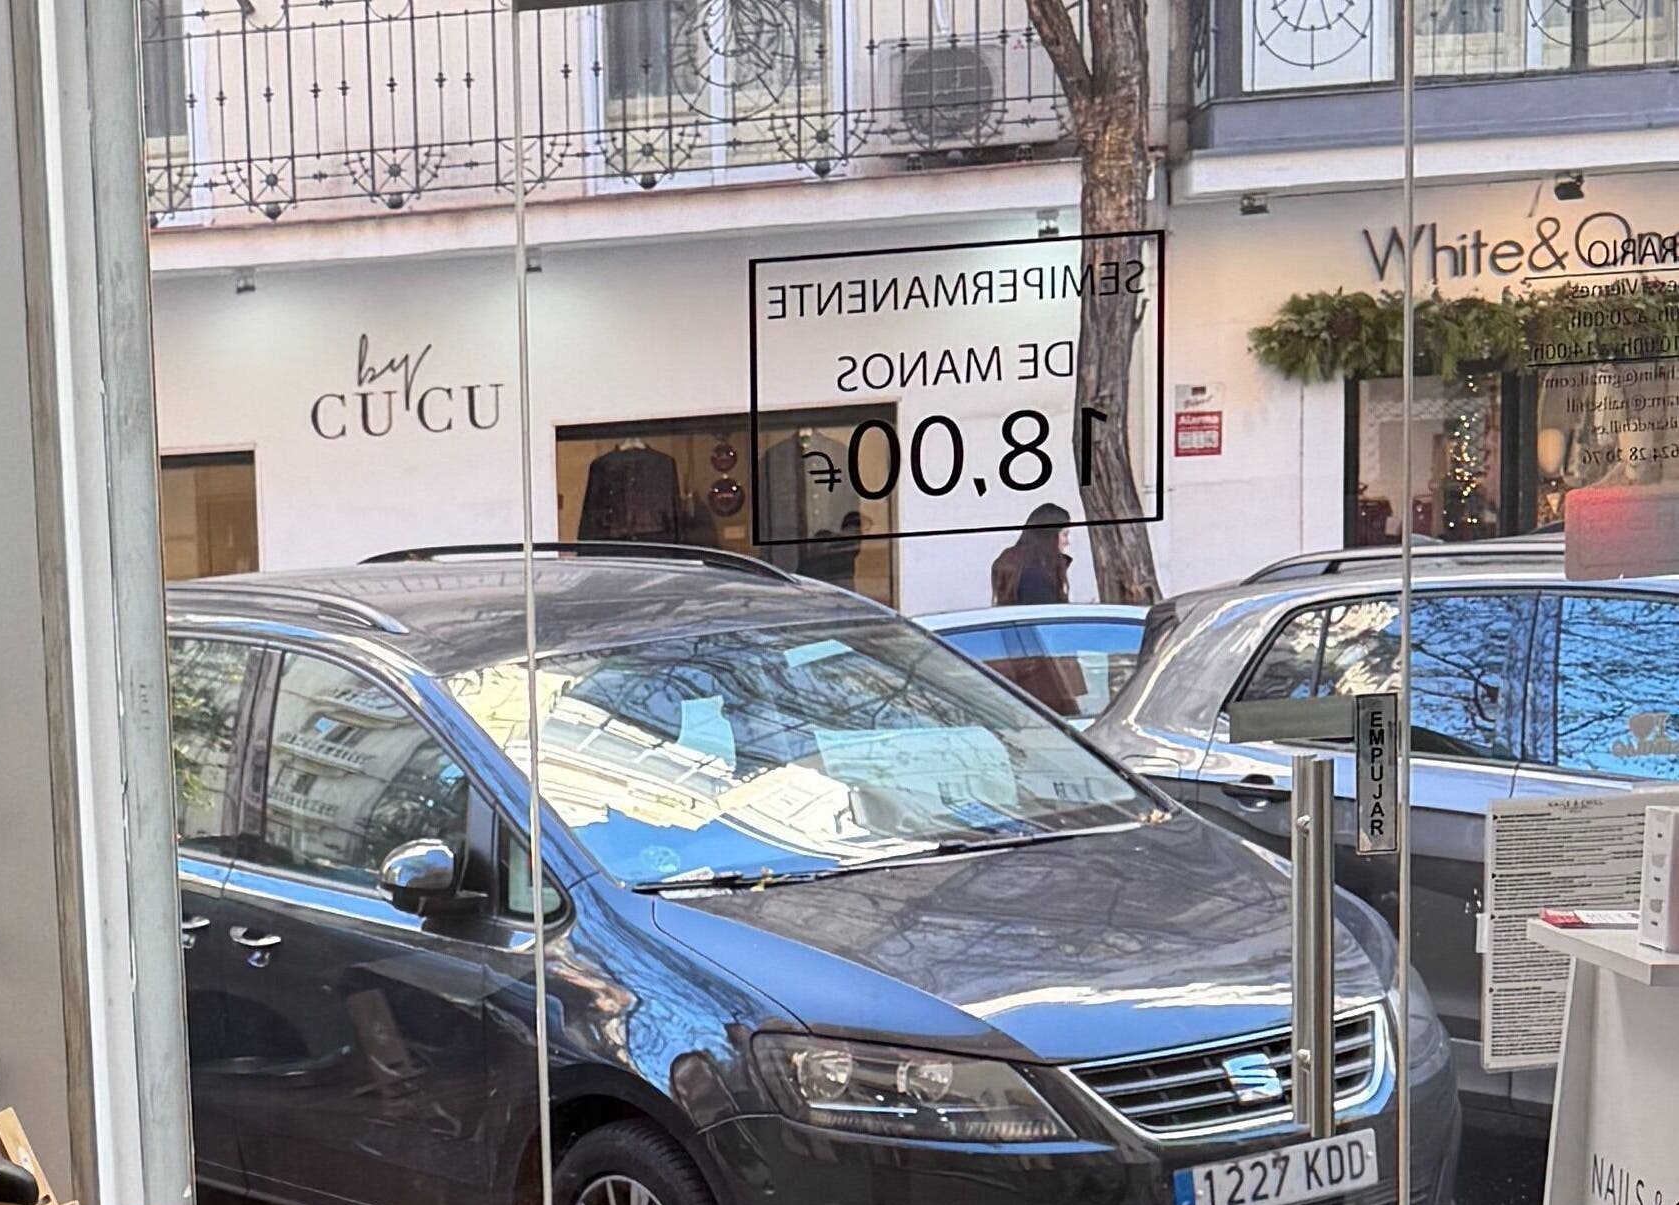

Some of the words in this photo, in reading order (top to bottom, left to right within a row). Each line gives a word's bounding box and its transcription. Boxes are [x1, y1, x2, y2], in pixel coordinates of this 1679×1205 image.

[357, 333, 432, 411] by
[1369, 711, 1385, 836] EMPUJAR
[1304, 1140, 1366, 1191] KDD
